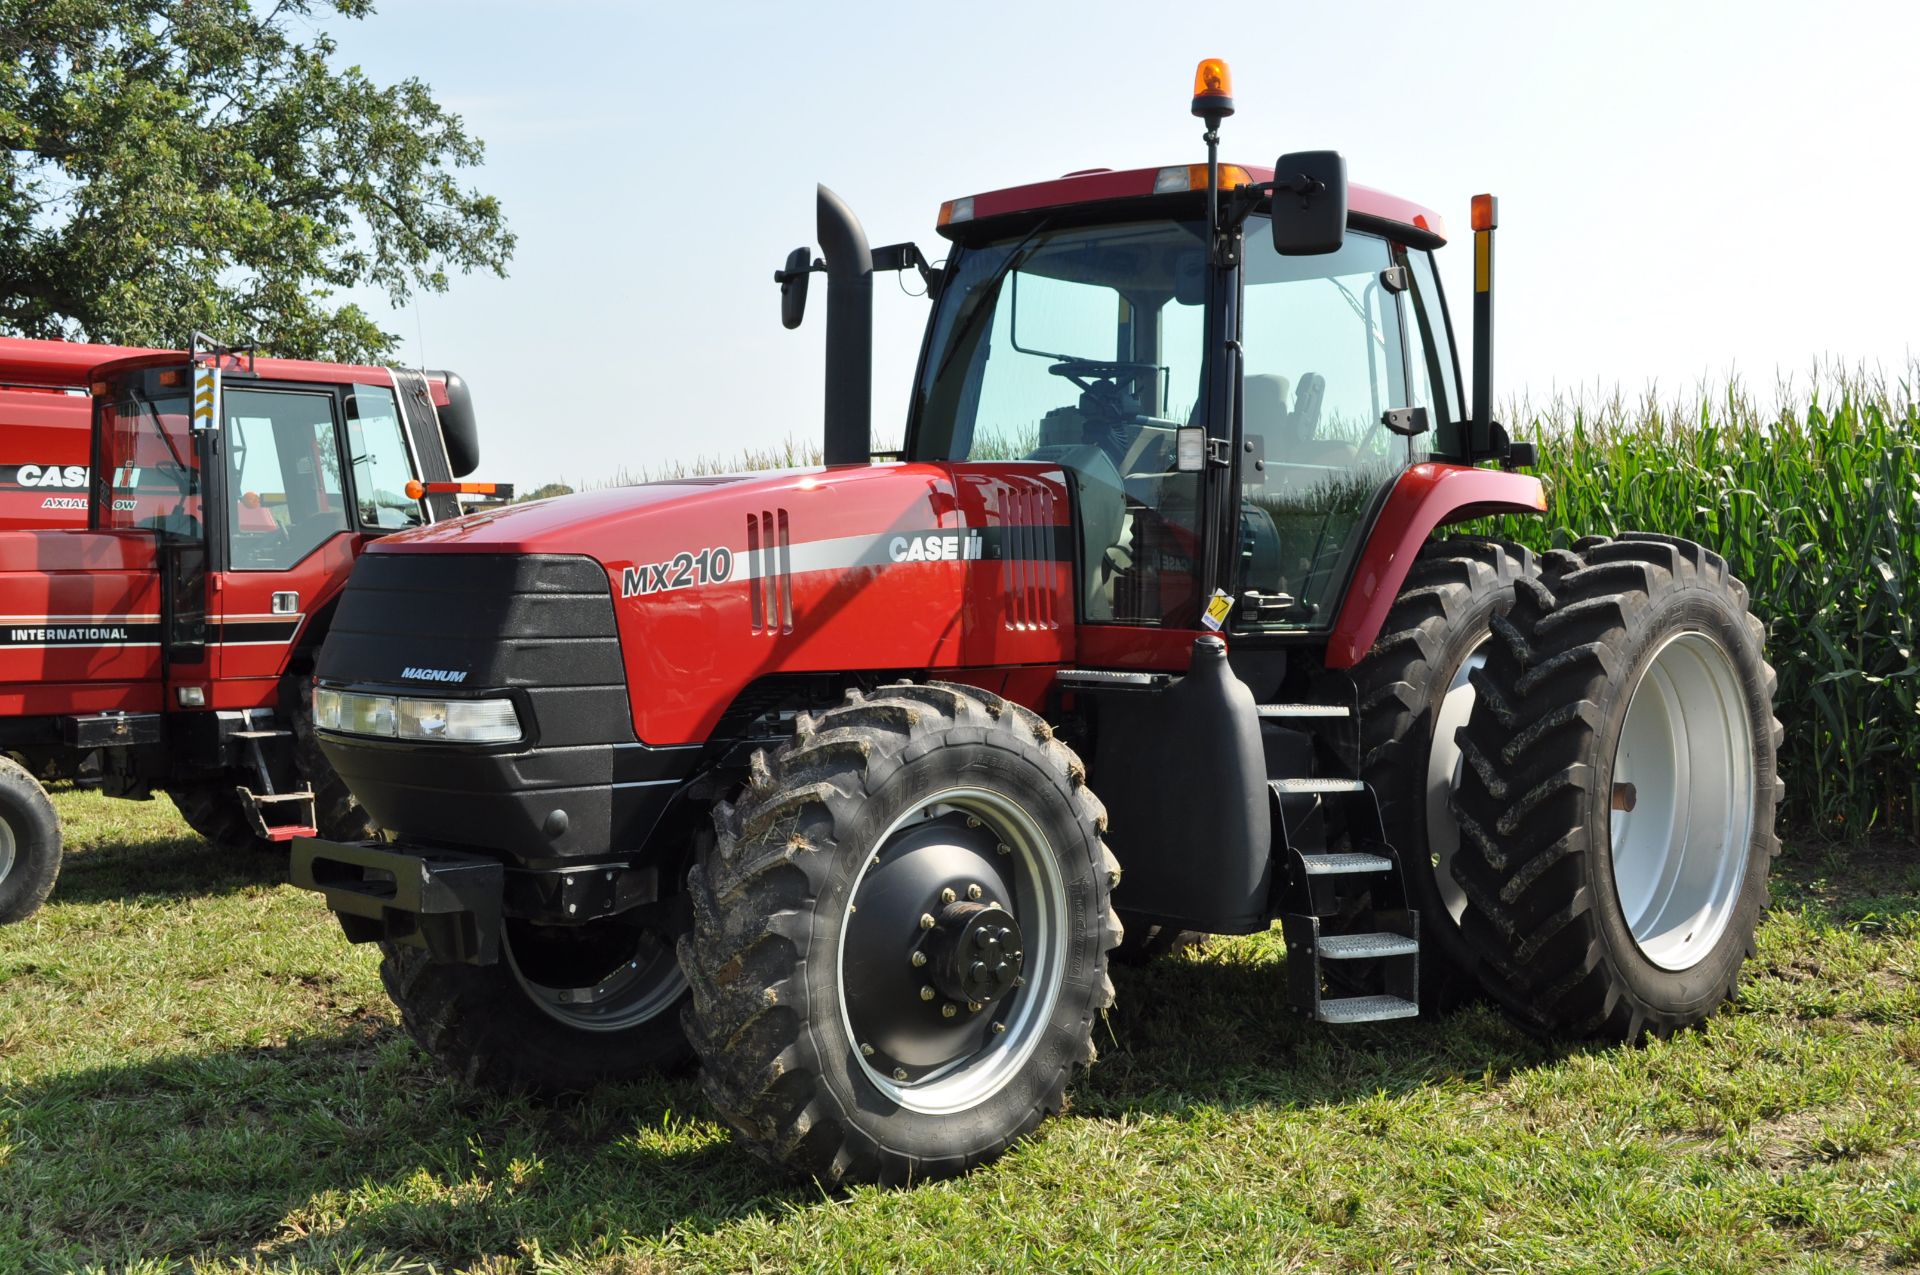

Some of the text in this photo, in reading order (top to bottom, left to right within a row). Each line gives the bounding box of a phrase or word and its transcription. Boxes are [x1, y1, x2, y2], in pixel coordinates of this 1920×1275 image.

[889, 535, 958, 562] CASE
[621, 547, 734, 598] MX210
[11, 627, 128, 641] INTERNATIONAL
[401, 667, 468, 683] MAGNUM
